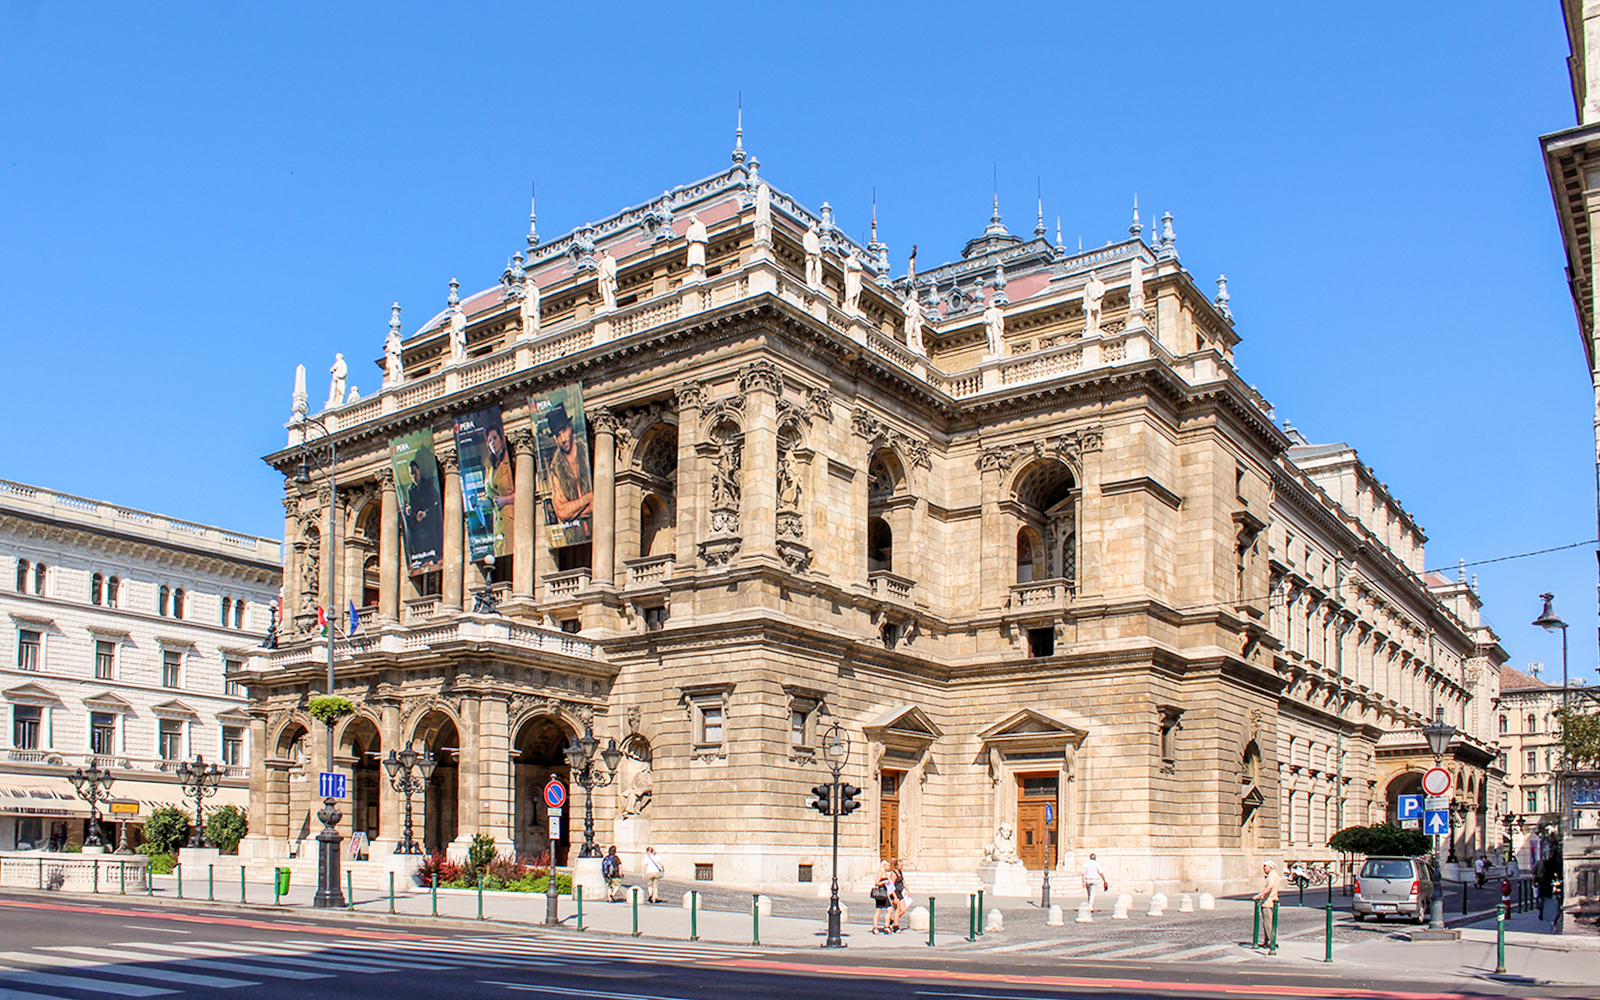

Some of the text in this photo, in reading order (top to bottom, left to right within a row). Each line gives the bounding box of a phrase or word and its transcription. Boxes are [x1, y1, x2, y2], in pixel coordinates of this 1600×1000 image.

[529, 400, 553, 413] OPERA
[453, 420, 476, 434] OPERA
[1404, 798, 1419, 817] P
